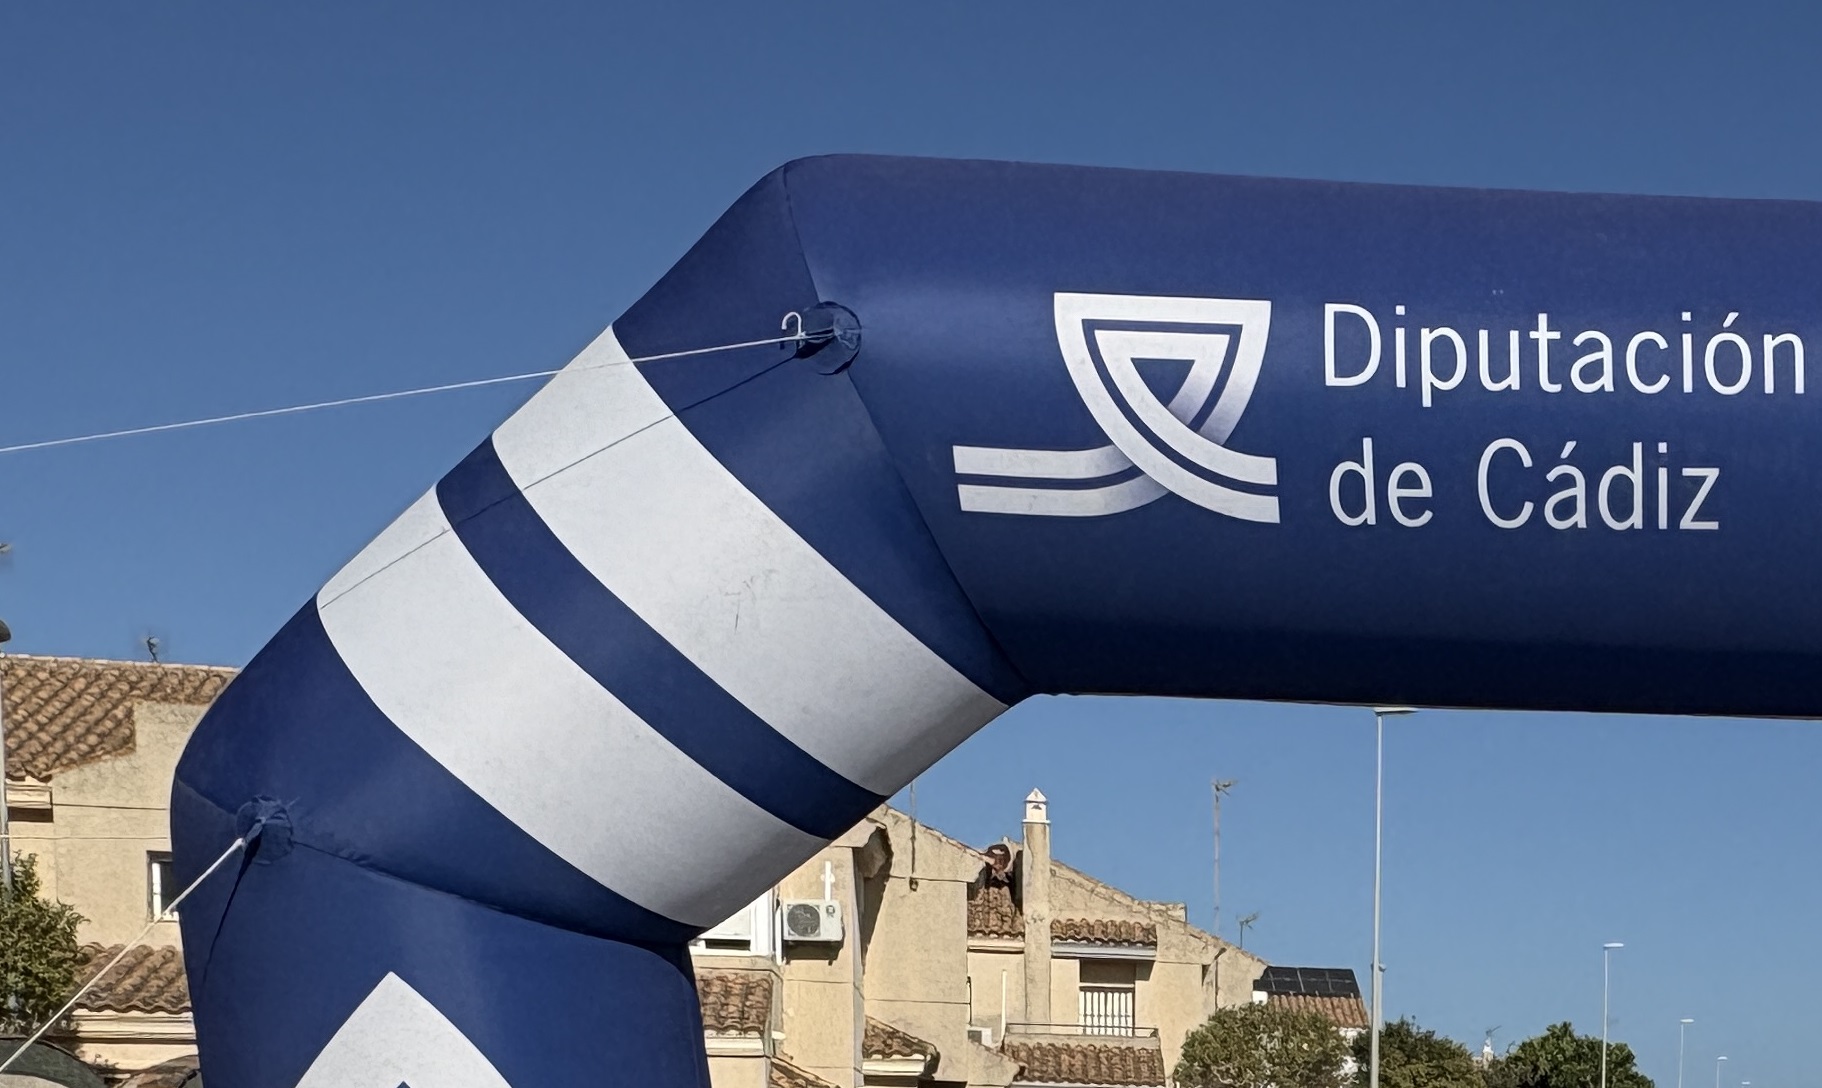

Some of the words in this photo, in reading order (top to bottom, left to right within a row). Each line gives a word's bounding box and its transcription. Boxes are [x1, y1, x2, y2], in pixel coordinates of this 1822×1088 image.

[1325, 303, 1804, 407] Diputación
[1330, 438, 1432, 527] de
[1478, 438, 1719, 530] Cádiz
